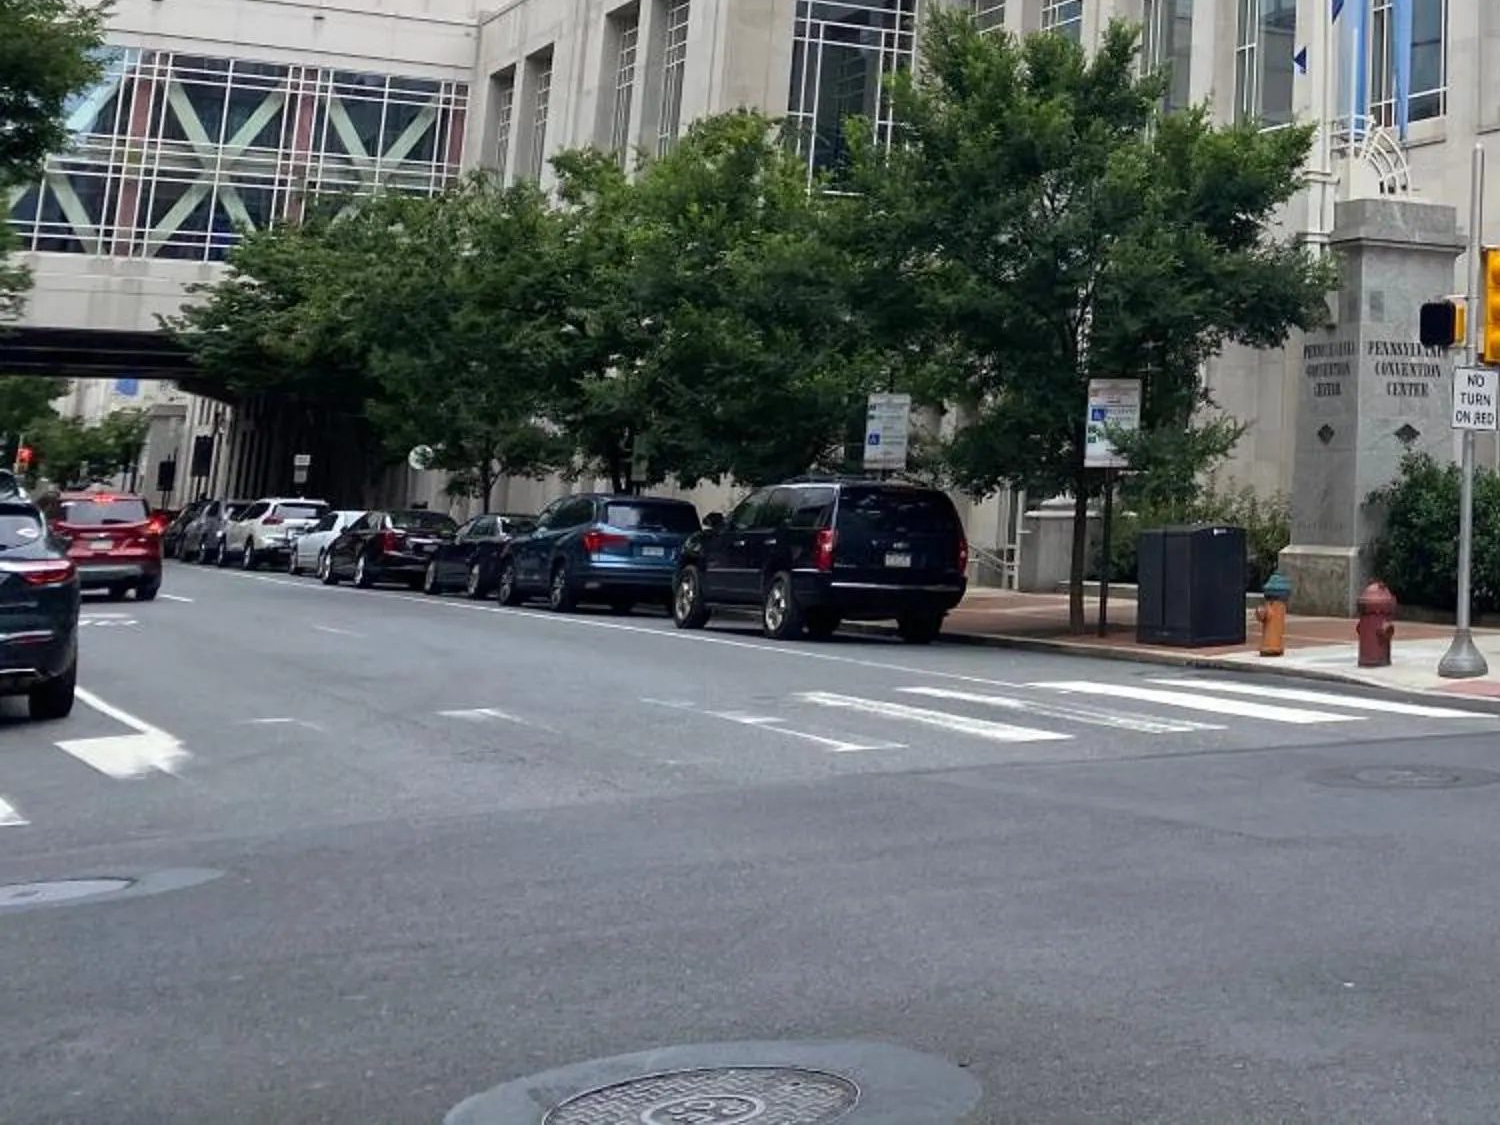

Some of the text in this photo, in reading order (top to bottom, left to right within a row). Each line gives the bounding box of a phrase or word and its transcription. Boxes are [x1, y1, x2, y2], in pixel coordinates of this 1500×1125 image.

[1467, 374, 1485, 388] NO
[1387, 382, 1429, 397] CENTER
[1460, 392, 1491, 406] TURN
[1455, 410, 1495, 425] ON RED
